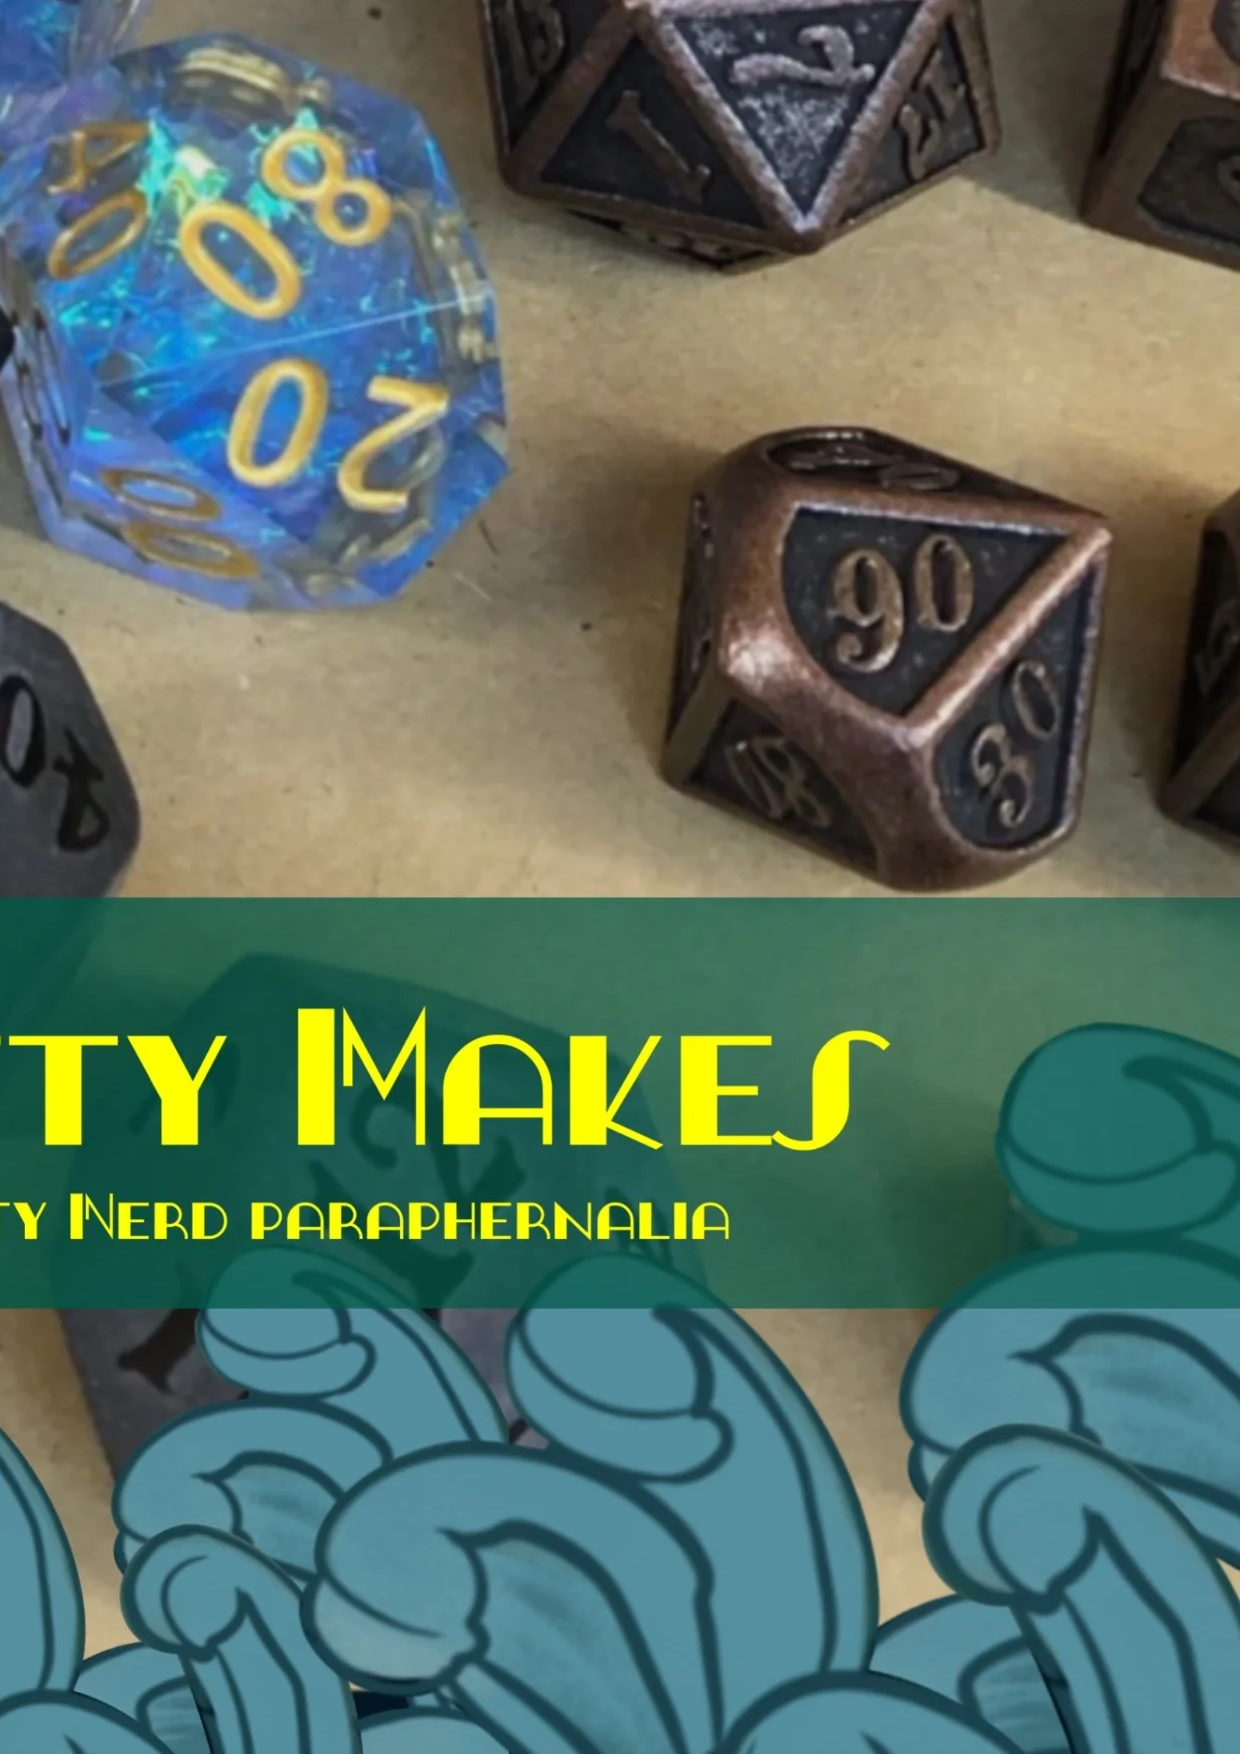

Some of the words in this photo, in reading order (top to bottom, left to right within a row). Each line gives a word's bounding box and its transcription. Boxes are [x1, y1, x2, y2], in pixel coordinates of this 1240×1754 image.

[178, 128, 393, 321] 80
[227, 357, 450, 515] 20
[826, 533, 975, 674] 90
[970, 659, 1059, 830] 30
